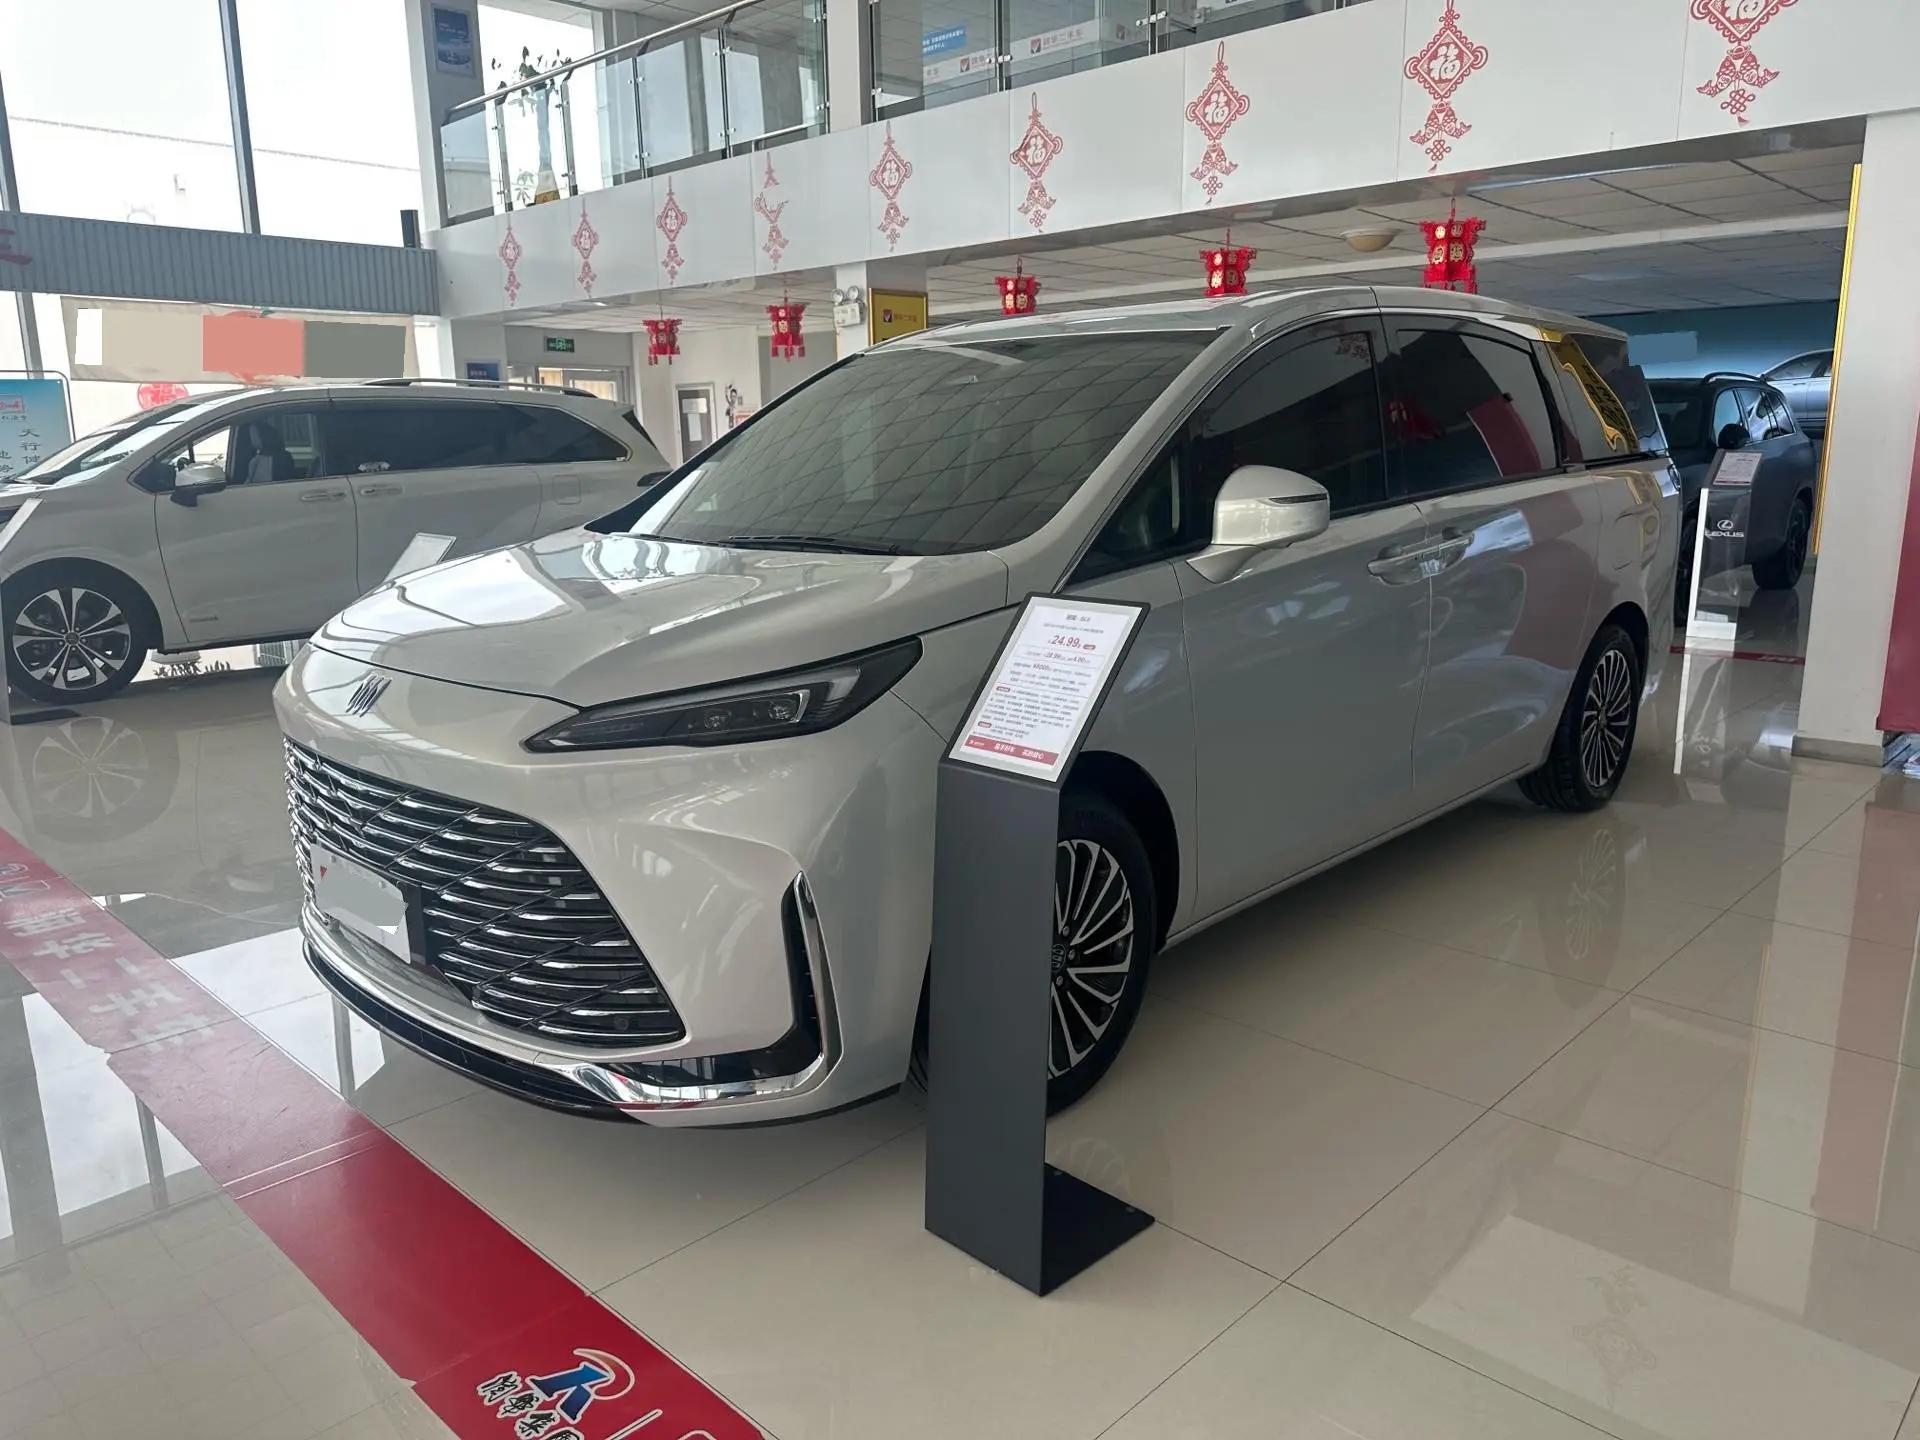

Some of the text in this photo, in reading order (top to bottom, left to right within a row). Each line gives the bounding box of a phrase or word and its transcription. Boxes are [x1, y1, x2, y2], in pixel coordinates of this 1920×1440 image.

[1428, 43, 1461, 81] 福
[1203, 90, 1229, 125] 福
[1026, 135, 1046, 165] 福
[881, 160, 900, 188] 福
[1705, 530, 1744, 538] LEXUS
